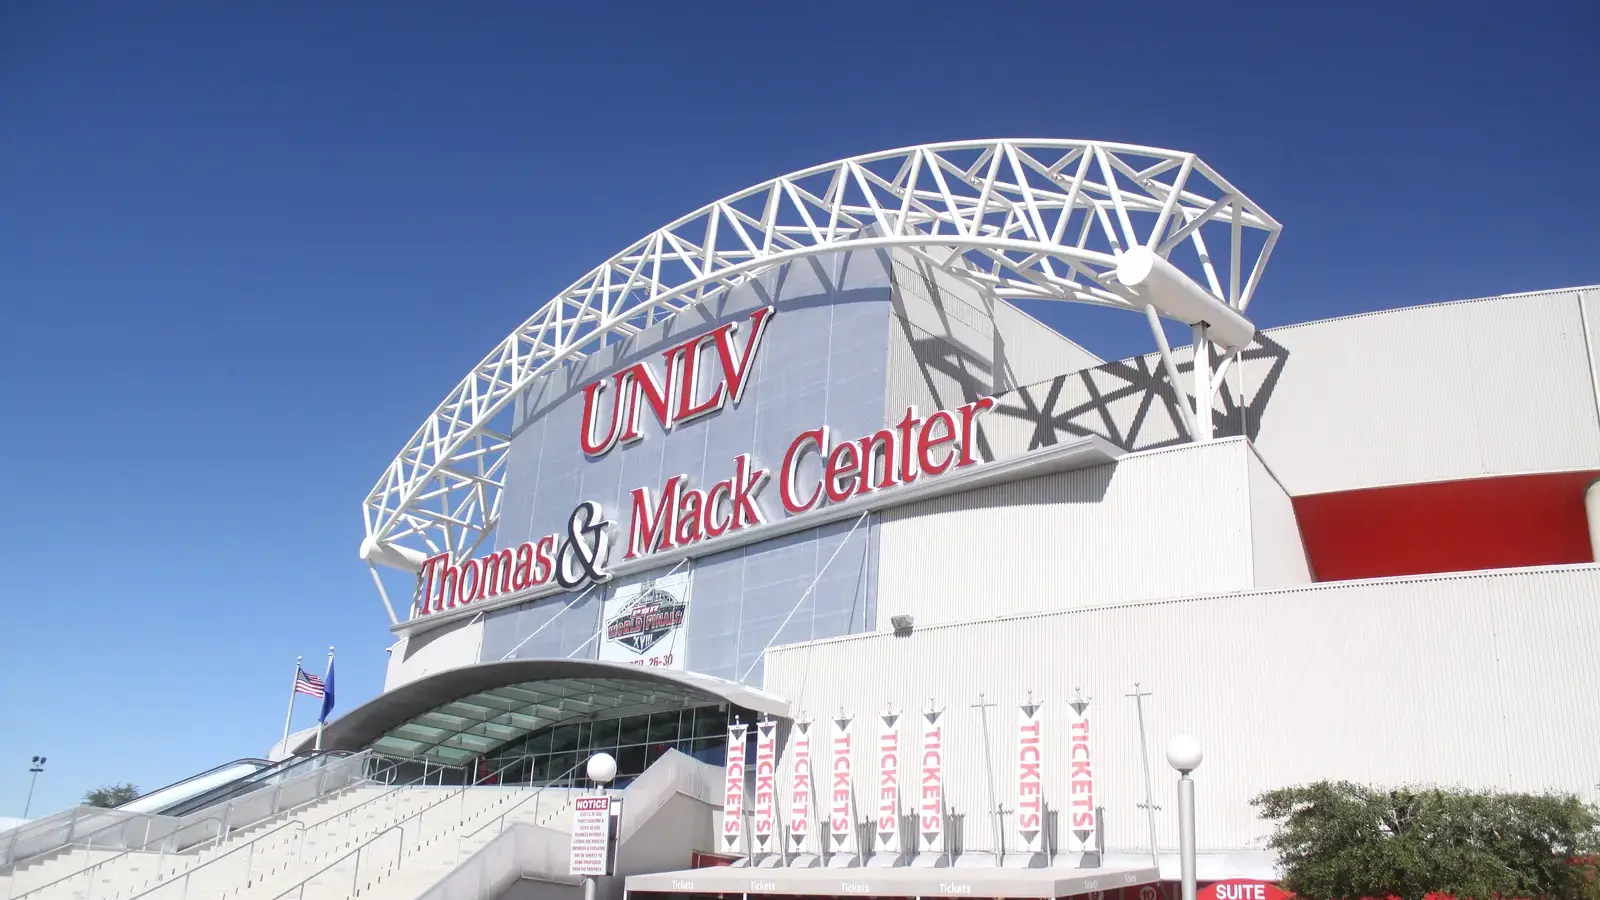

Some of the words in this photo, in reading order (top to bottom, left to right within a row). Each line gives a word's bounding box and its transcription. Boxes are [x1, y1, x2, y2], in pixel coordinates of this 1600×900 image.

[580, 306, 774, 457] UNLV
[420, 533, 560, 615] Thomas
[555, 501, 614, 591] &
[623, 453, 771, 560] Mack
[780, 396, 1000, 514] Center
[608, 617, 642, 639] WORLD
[644, 611, 683, 631] FINALS
[648, 653, 673, 667] 26-30
[576, 799, 607, 809] NOTICE
[725, 742, 745, 833] TICKETS
[756, 739, 774, 833] TICKETS
[791, 740, 809, 832] TICKETS
[832, 733, 851, 832] TICKETS
[879, 730, 898, 830] TICKETS
[922, 727, 941, 830] TICKETS
[1020, 720, 1041, 830] TICKETS
[1071, 718, 1094, 829] TICKETS
[672, 880, 694, 890] Tickets
[750, 881, 776, 891] Tickets
[841, 882, 870, 893] Tickets
[939, 883, 971, 895] Tickets
[1215, 884, 1266, 900] SUITE
